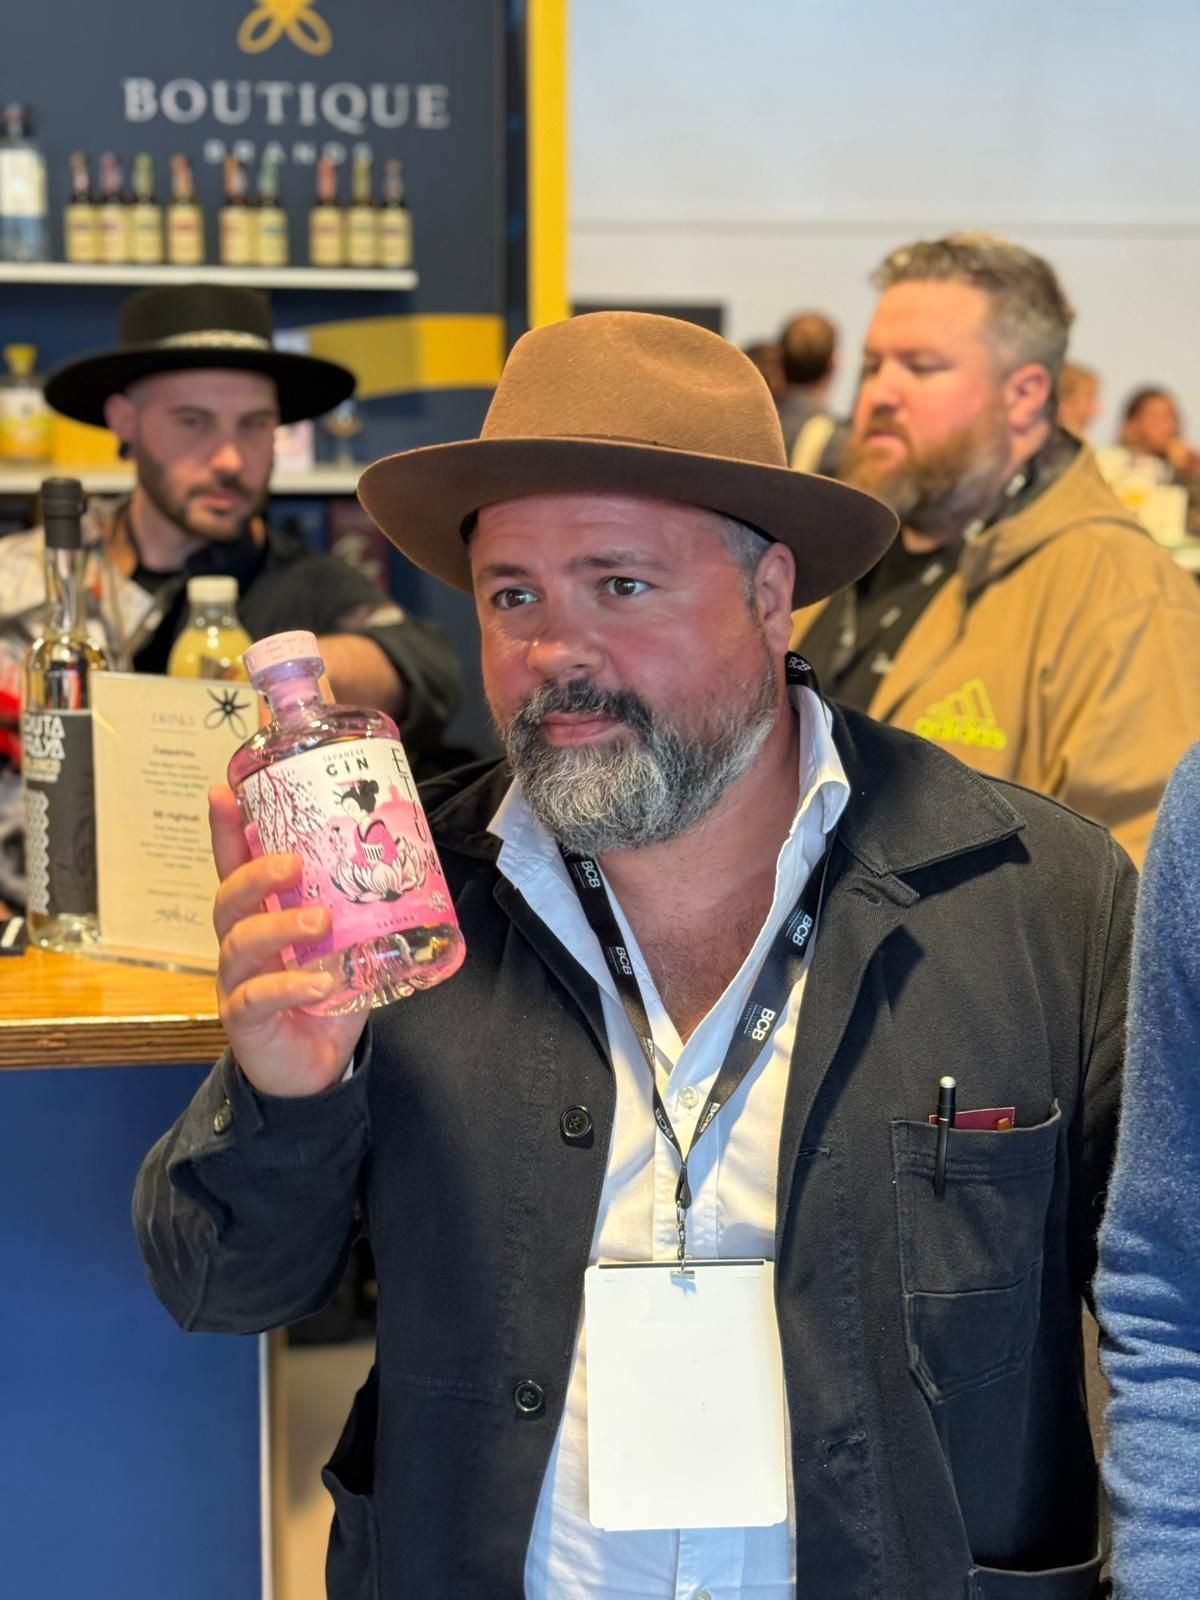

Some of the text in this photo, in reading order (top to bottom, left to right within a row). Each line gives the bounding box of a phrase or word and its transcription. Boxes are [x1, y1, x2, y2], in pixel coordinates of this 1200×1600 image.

[124, 77, 450, 135] BOUTIQUE
[788, 656, 812, 671] BCB
[914, 718, 1007, 751] adidas
[326, 757, 369, 777] GIN
[581, 860, 601, 888] BCB
[792, 913, 813, 946] BCB
[615, 946, 633, 975] BCB
[751, 1007, 776, 1041] BCB
